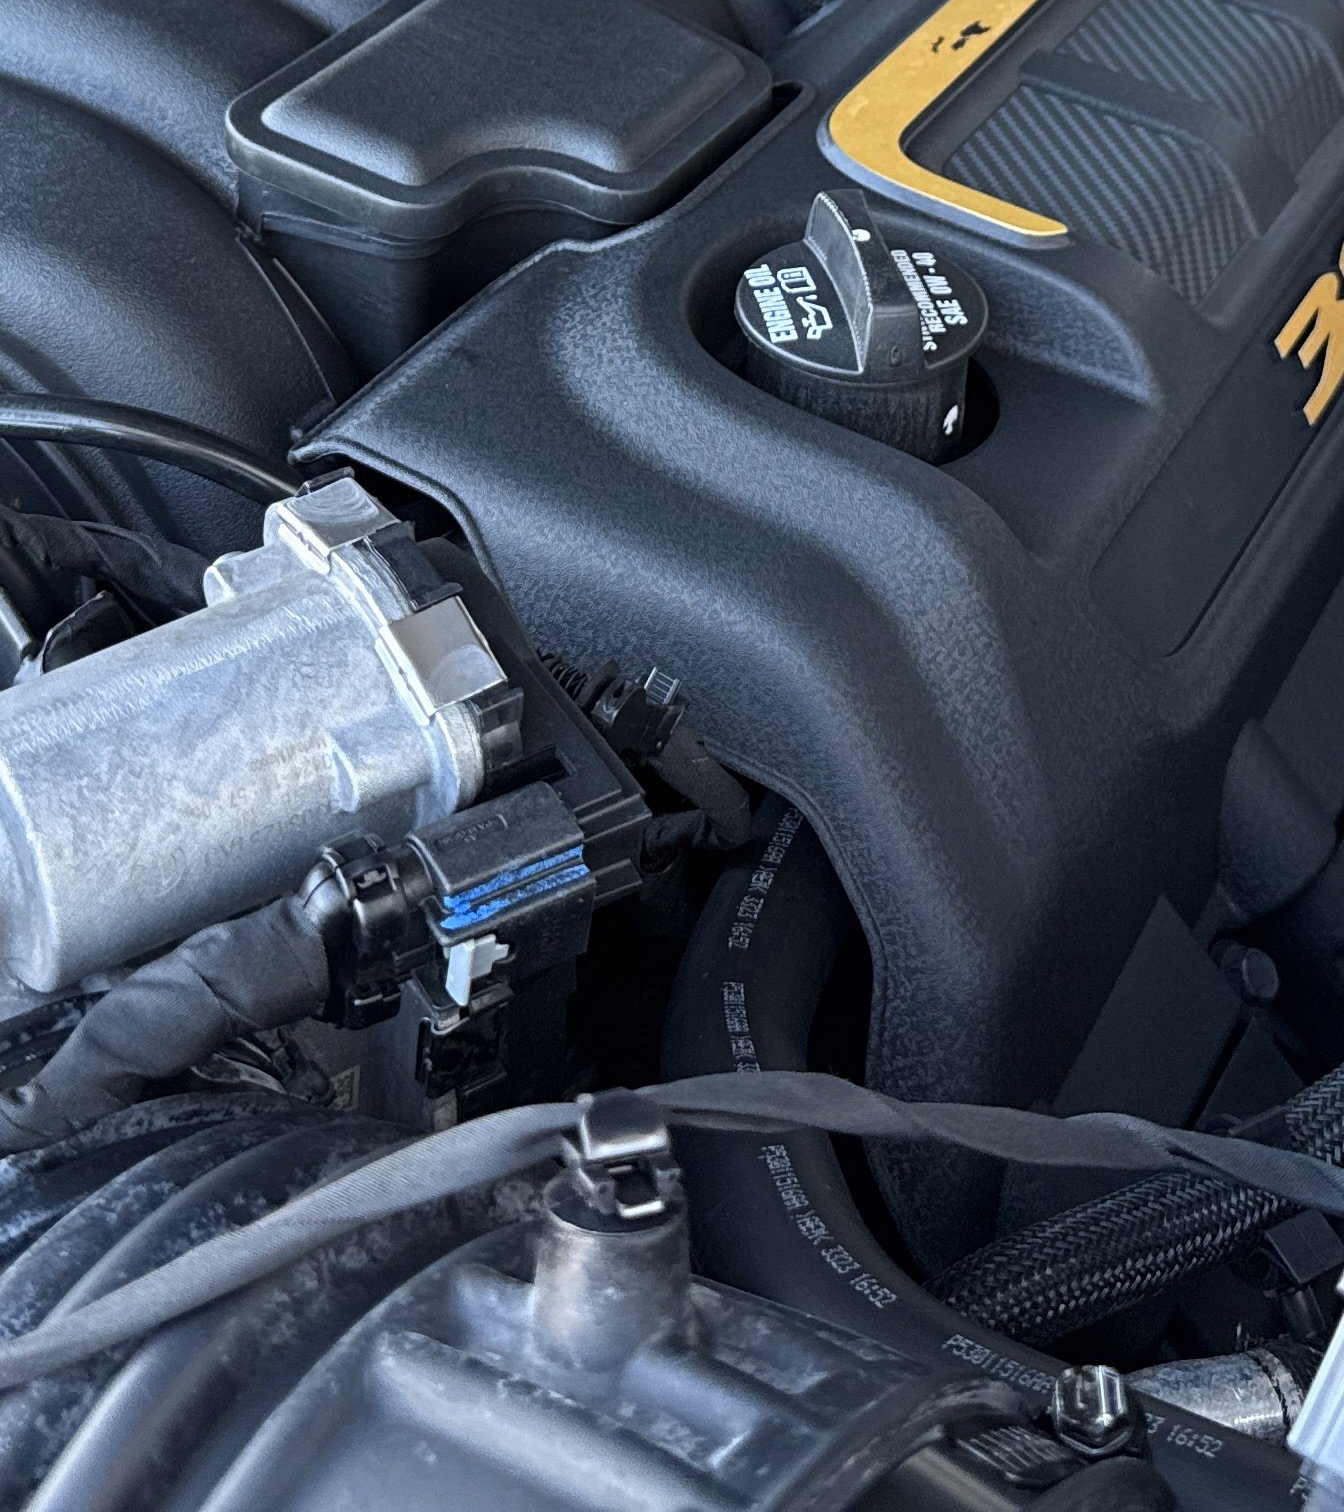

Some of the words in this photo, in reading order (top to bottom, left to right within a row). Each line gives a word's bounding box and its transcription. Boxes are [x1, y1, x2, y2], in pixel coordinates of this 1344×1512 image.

[744, 264, 776, 287] OIL
[891, 249, 946, 333] RECOMMENDED
[754, 286, 798, 343] ENGINE
[936, 299, 968, 326] SAE
